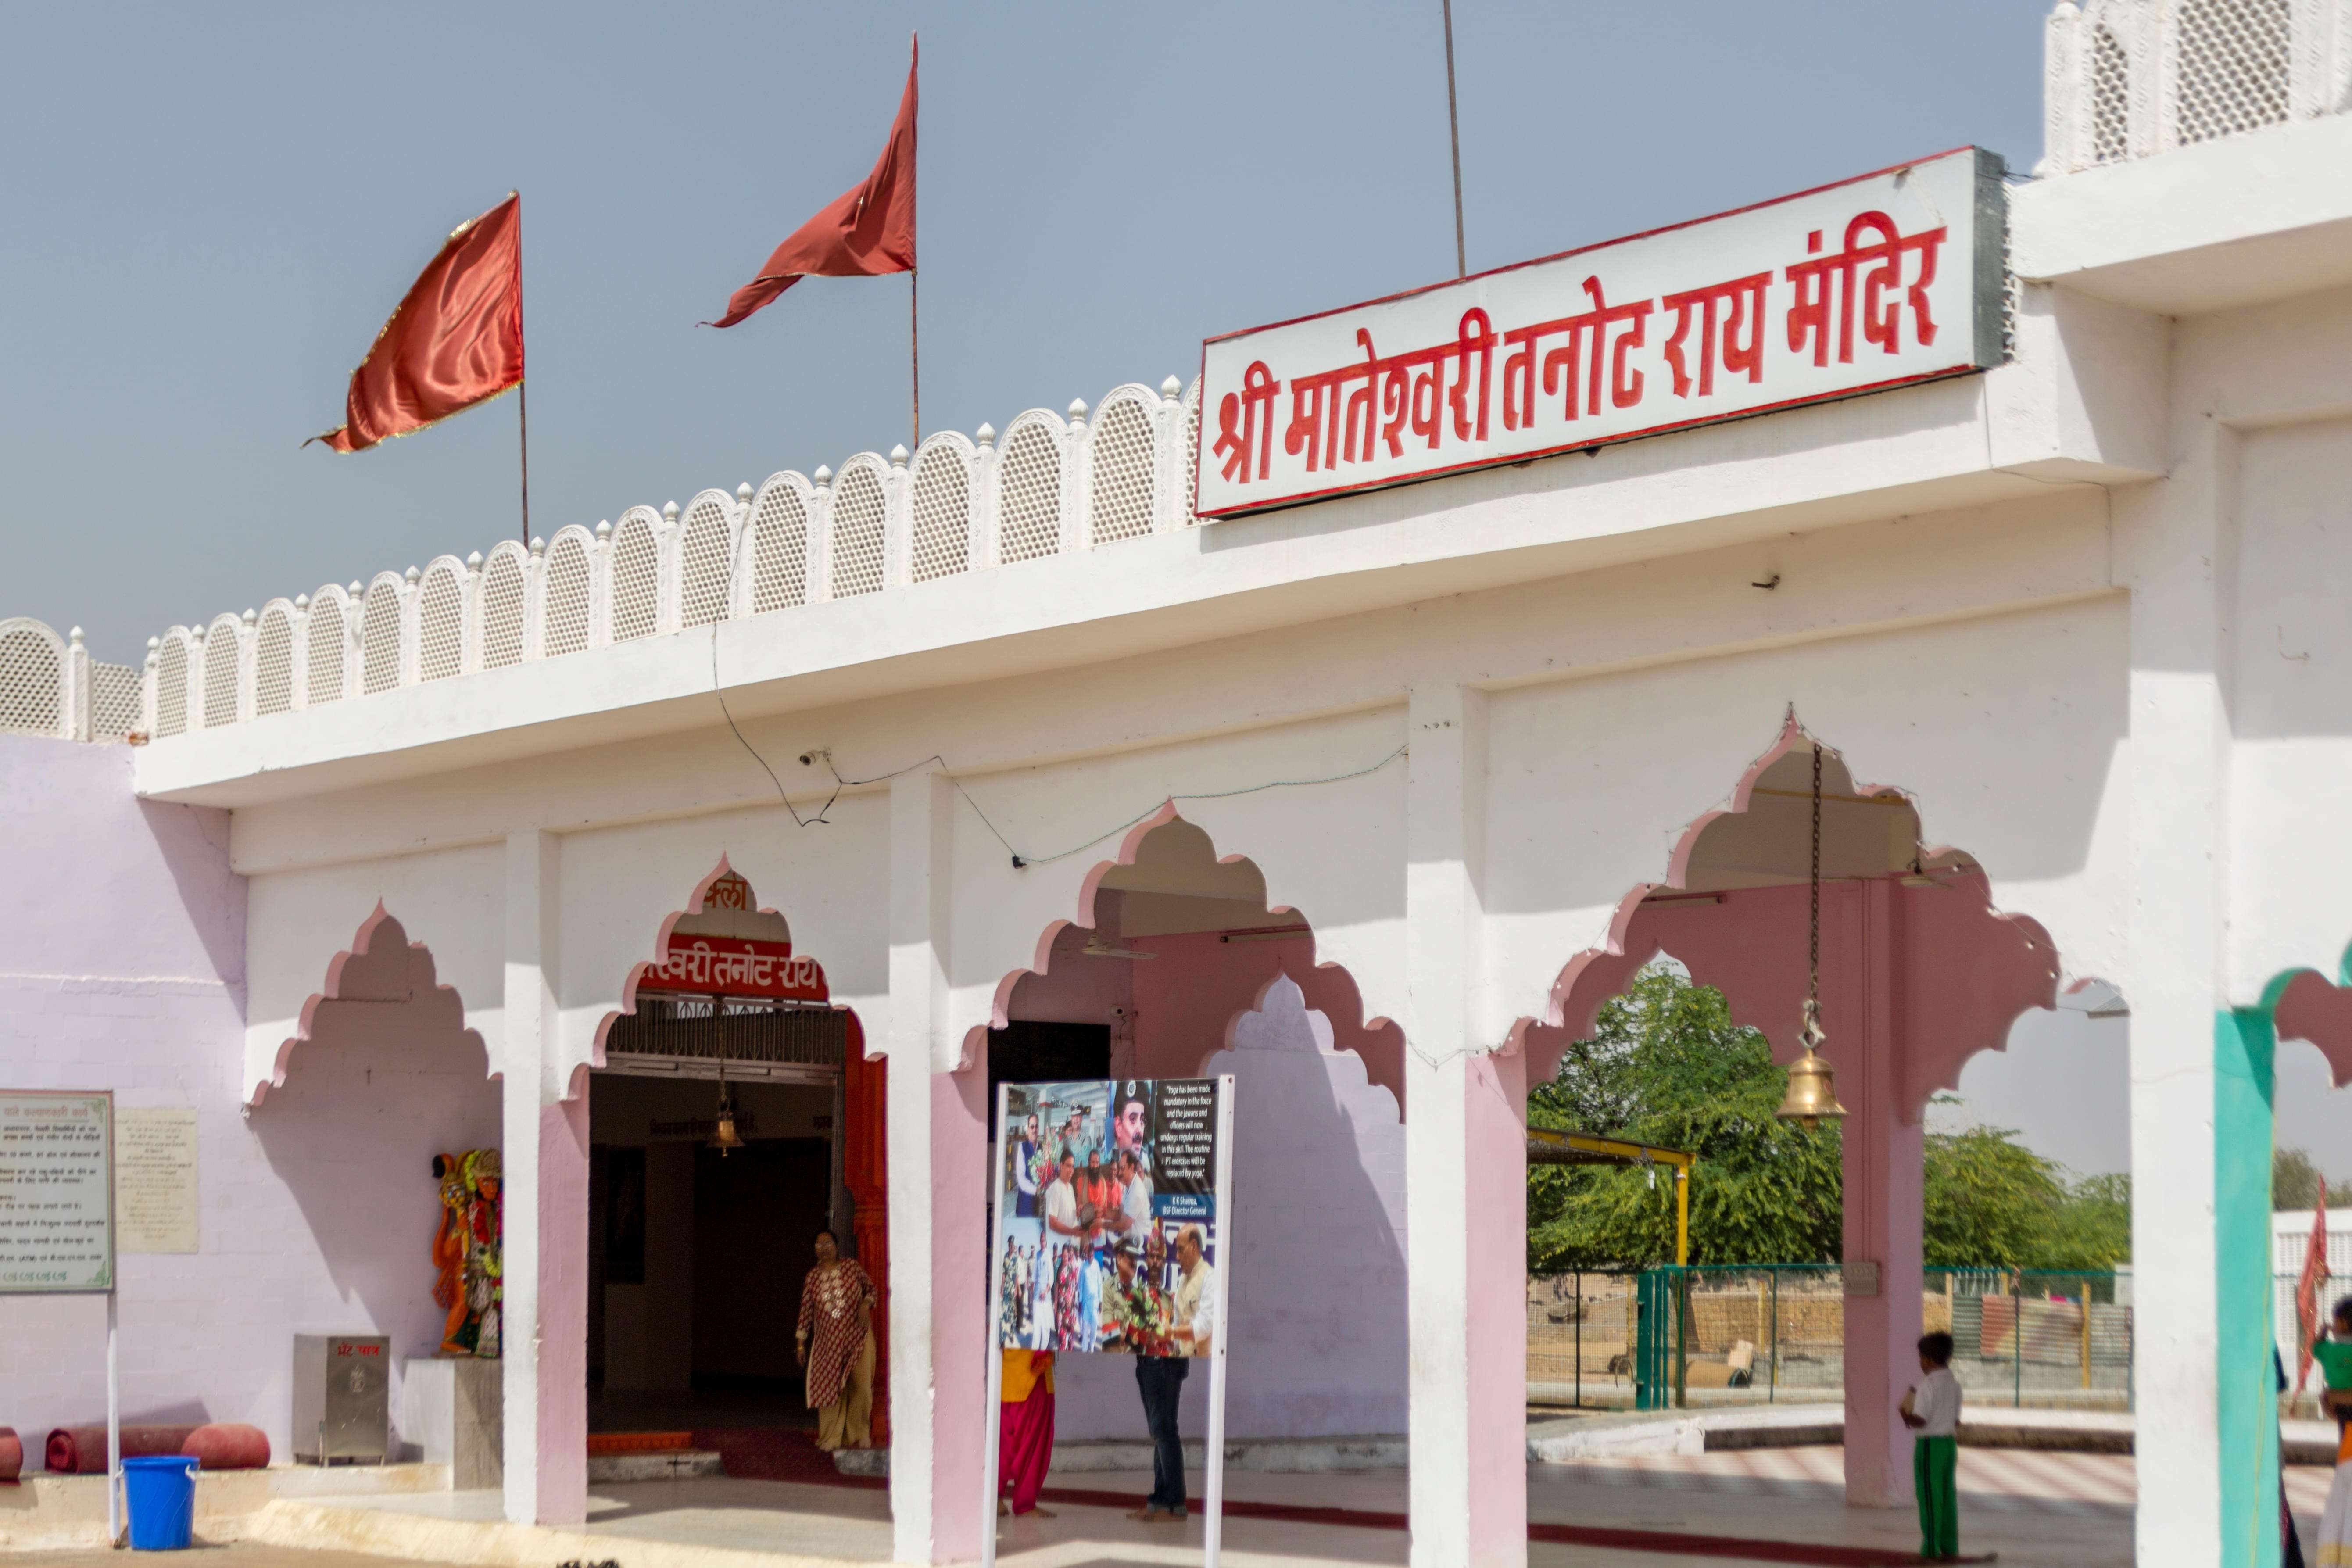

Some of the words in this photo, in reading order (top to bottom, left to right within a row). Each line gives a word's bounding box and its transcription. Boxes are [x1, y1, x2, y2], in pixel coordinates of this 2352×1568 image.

[1212, 360, 1280, 484] श्री
[1285, 307, 1498, 472] मातेश्वरी
[1504, 276, 1654, 431] तनोट
[1662, 270, 1772, 398] राय
[1786, 211, 1947, 368] मंदिर
[715, 944, 778, 987] तनोट
[779, 957, 817, 989] राय
[1187, 1085, 1198, 1093] been
[1199, 1084, 1211, 1093] made
[1164, 1097, 1187, 1107] mandatory
[1187, 1097, 1192, 1105] in
[1200, 1096, 1212, 1105] force
[1167, 1109, 1175, 1117] and
[1183, 1109, 1198, 1119] jawans
[1199, 1108, 1207, 1117] and
[1170, 1121, 1185, 1129] officers
[1160, 1133, 1178, 1143] undergo
[1179, 1132, 1194, 1143] regular
[1195, 1132, 1212, 1143] training
[1162, 1145, 1166, 1153] in
[1167, 1145, 1175, 1153] this
[1185, 1144, 1193, 1153] The
[1194, 1144, 1210, 1153] routine
[1165, 1156, 1171, 1165] PT
[1191, 1156, 1199, 1165] will
[1199, 1156, 1206, 1165] be
[1166, 1168, 1184, 1178] replaced
[1185, 1168, 1192, 1179] by
[1172, 1196, 1176, 1205] K
[1176, 1196, 1180, 1205] K
[1180, 1196, 1197, 1206] Sharma,
[1172, 1206, 1189, 1215] Director
[1189, 1206, 1207, 1215] General
